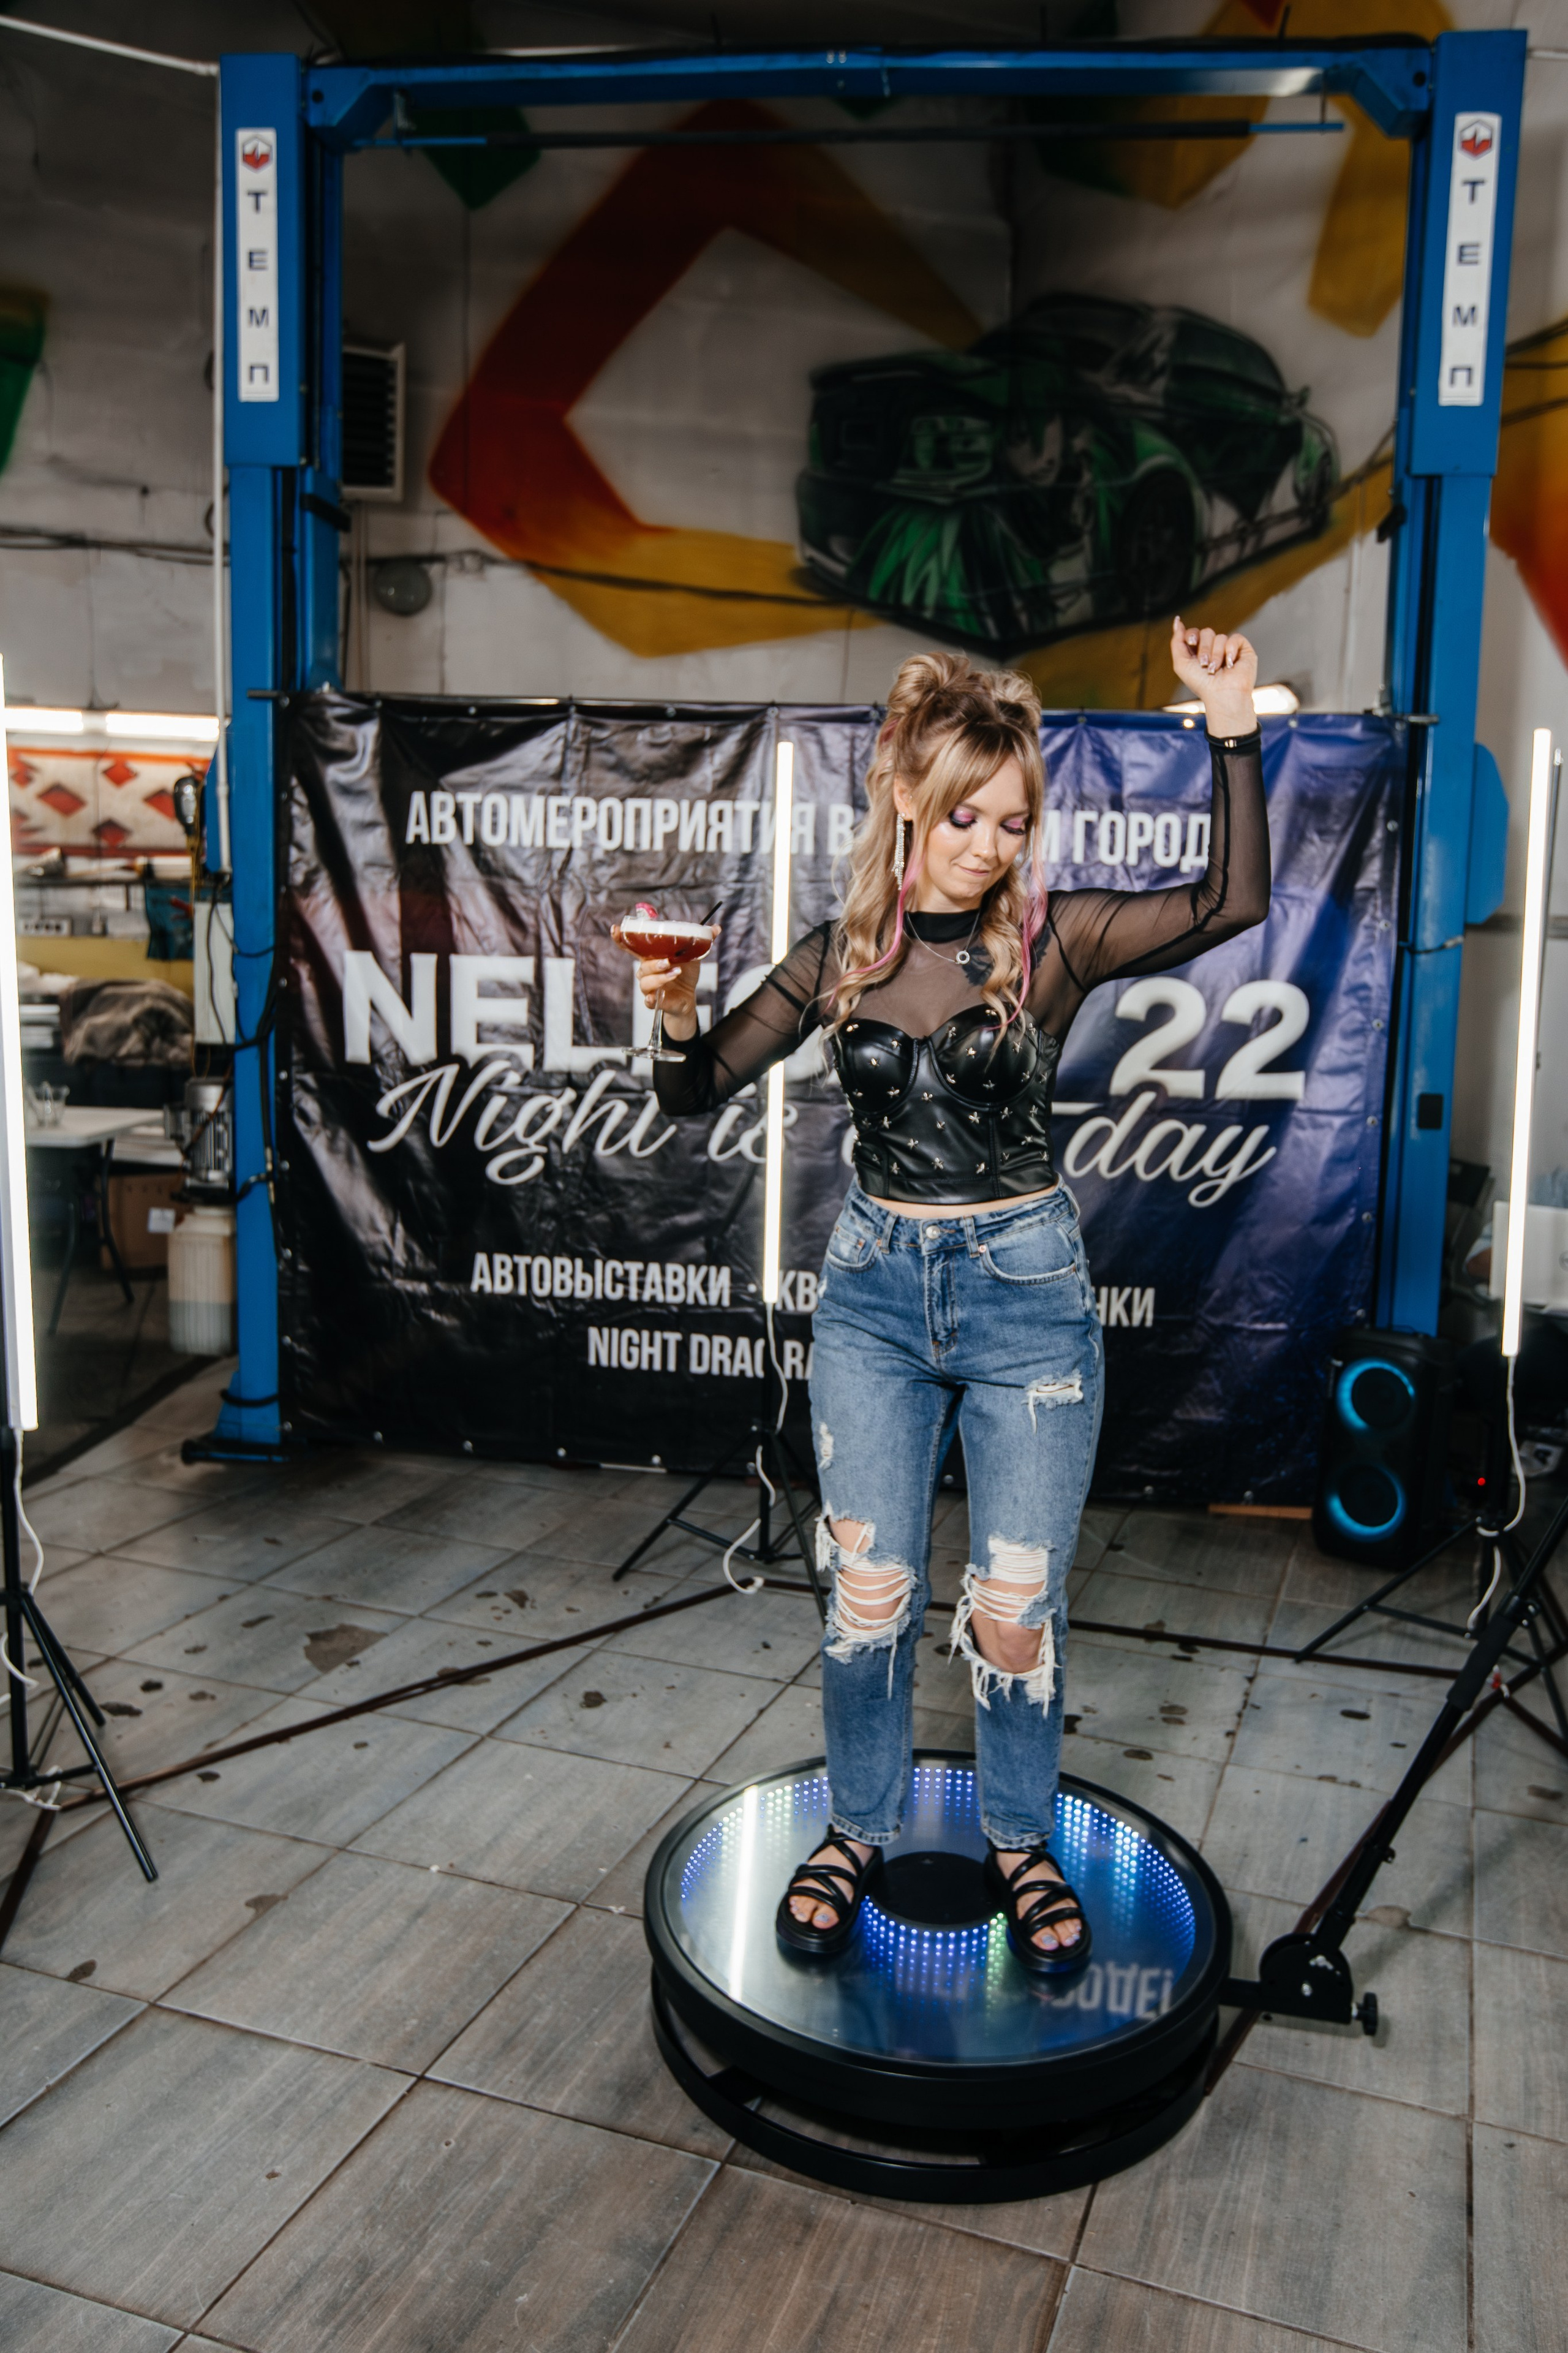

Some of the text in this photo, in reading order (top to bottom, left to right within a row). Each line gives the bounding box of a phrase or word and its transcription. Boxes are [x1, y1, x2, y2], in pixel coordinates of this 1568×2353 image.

[247, 191, 269, 385] ТЕМП
[1449, 180, 1487, 388] ТЕМП
[827, 803, 855, 856] В
[1072, 810, 1212, 874] ГОРОД
[1109, 976, 1310, 1100] 22
[1063, 1090, 1277, 1208] day
[470, 1252, 731, 1307] АВТОВЫСТАВКИ
[1091, 1286, 1156, 1328] НКИ
[587, 1326, 682, 1372] NIGHT
